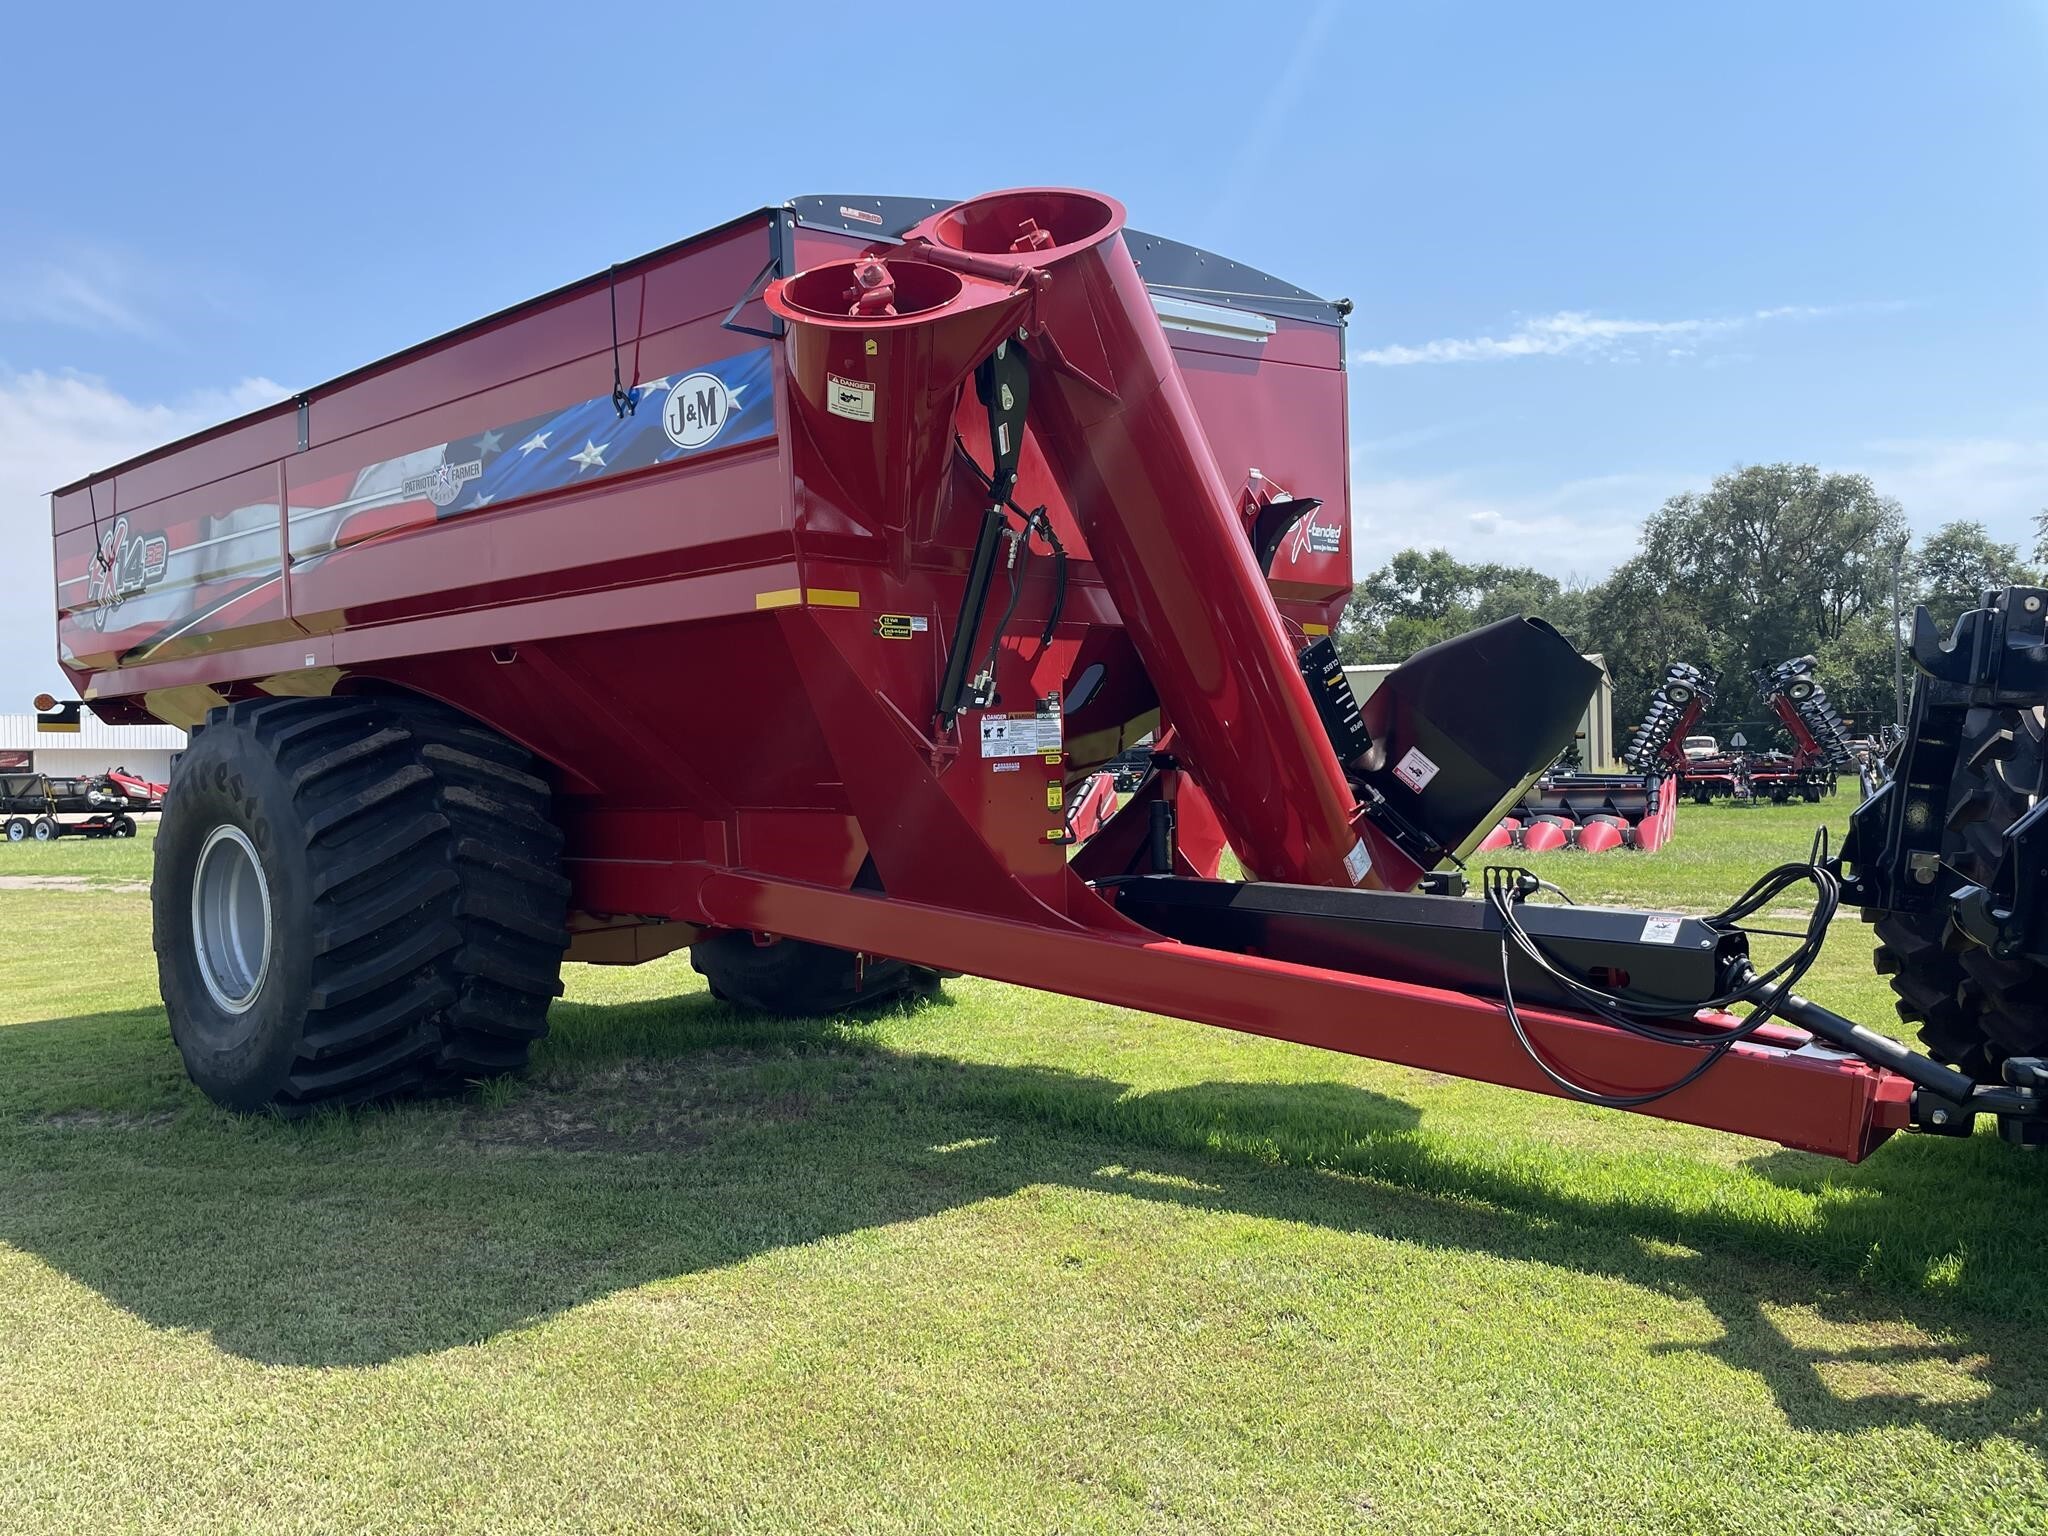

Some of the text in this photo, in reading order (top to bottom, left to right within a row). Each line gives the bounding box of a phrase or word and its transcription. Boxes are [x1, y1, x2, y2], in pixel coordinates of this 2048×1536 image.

[840, 378, 870, 390] DANGER
[669, 386, 718, 436] J&M
[404, 463, 480, 494] PATRIOTIC FARMER
[1323, 658, 1339, 674] CLOSE
[1350, 720, 1363, 733] OPEN
